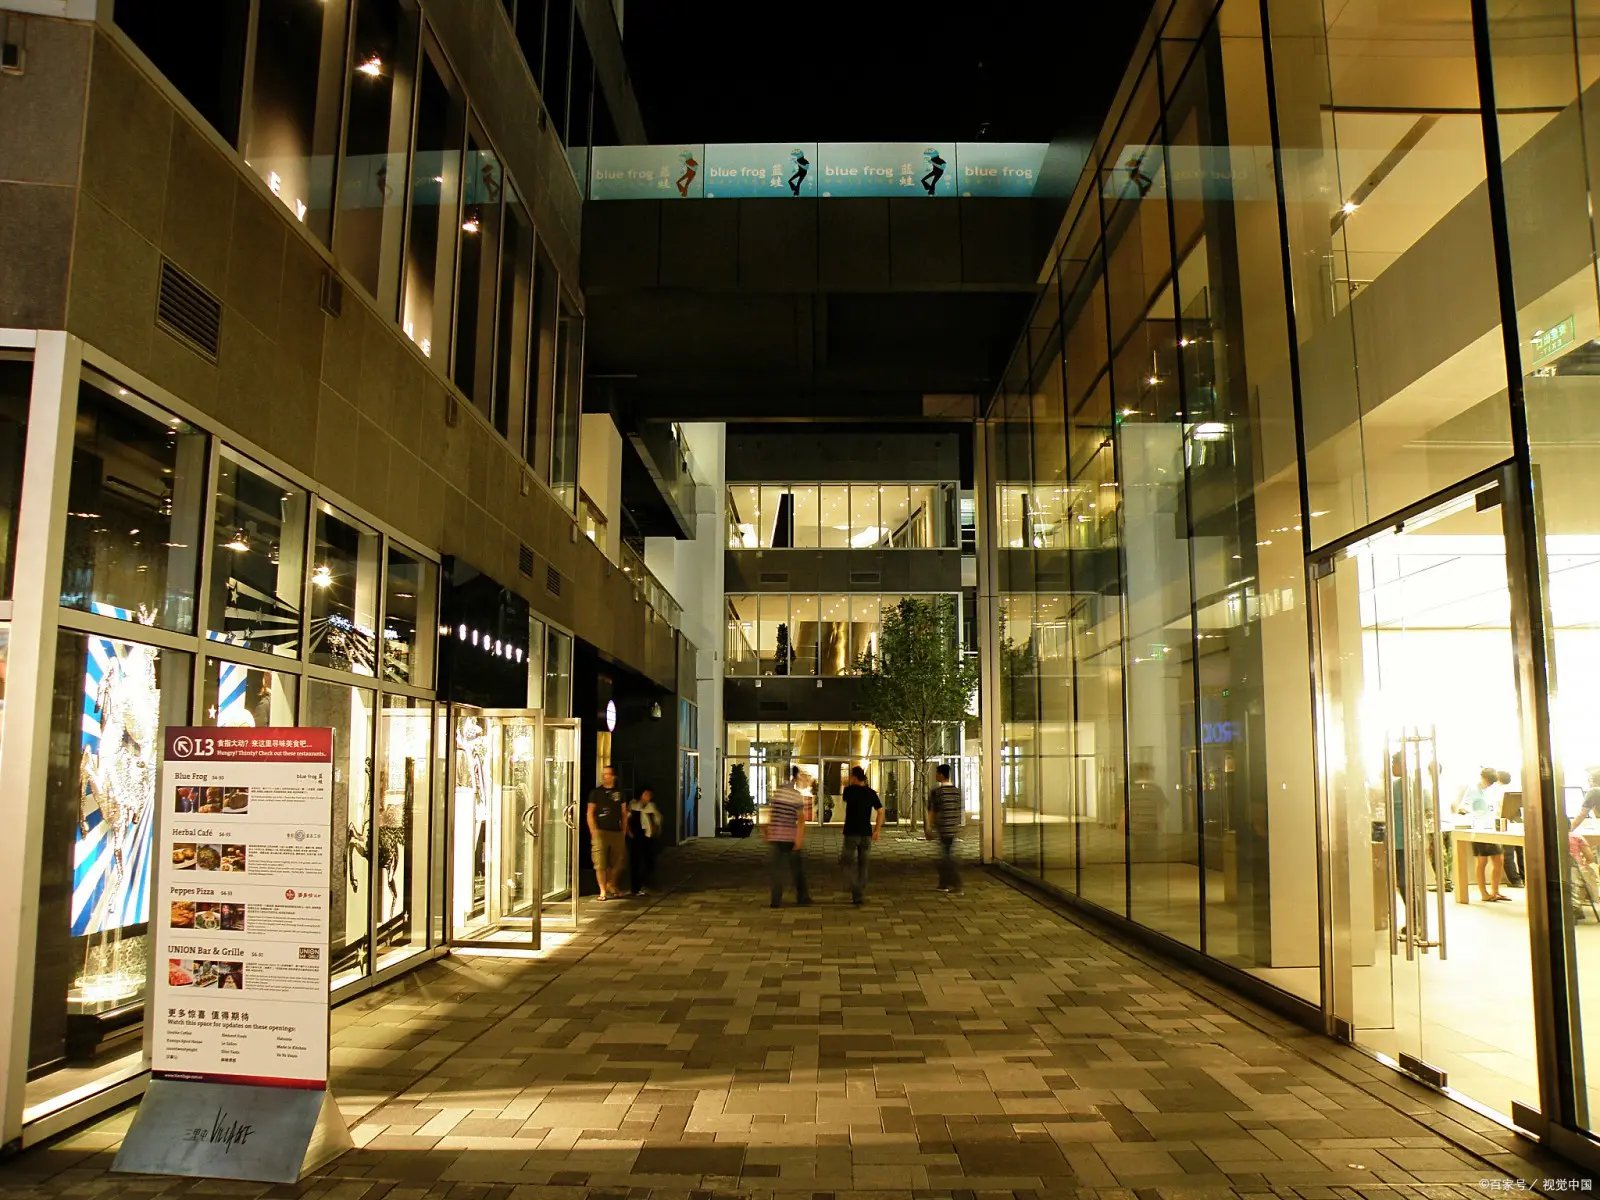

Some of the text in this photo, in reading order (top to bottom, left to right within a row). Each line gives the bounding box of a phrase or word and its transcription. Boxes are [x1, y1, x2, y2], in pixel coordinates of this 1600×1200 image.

[596, 168, 654, 181] blue frog
[710, 167, 766, 179] blue frog
[825, 165, 894, 177] blue frog
[965, 166, 1033, 179] blue frog
[194, 738, 215, 756] L3
[192, 773, 207, 781] Frog
[197, 829, 213, 837] Café
[170, 887, 195, 896] Peppes
[196, 887, 214, 895] Pizza
[168, 945, 196, 954] UNION
[197, 947, 211, 955] Bar
[212, 947, 220, 955] &
[221, 948, 244, 957] Grille
[167, 1008, 249, 1022] 更多惊喜 值得期待
[222, 1022, 244, 1030] updates
